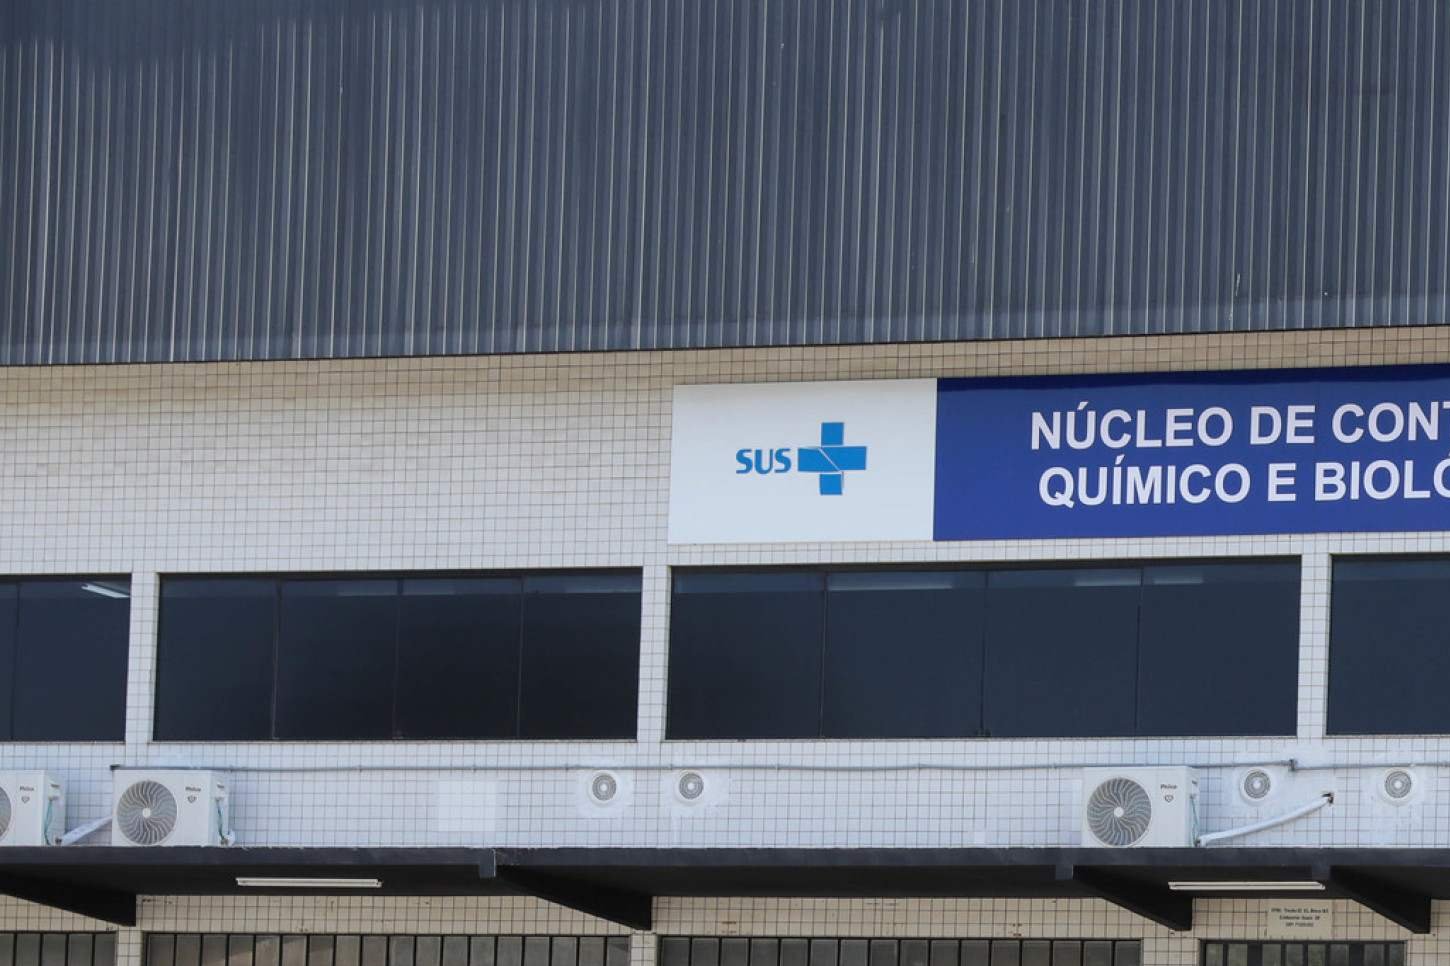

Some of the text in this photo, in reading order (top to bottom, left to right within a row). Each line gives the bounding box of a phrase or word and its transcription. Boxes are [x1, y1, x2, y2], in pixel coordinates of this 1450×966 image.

[1030, 401, 1233, 451] NÚCLEO
[1250, 404, 1316, 445] DE
[735, 447, 792, 475] SUS
[1039, 454, 1251, 508] QUÍMICO
[1267, 462, 1298, 502] E
